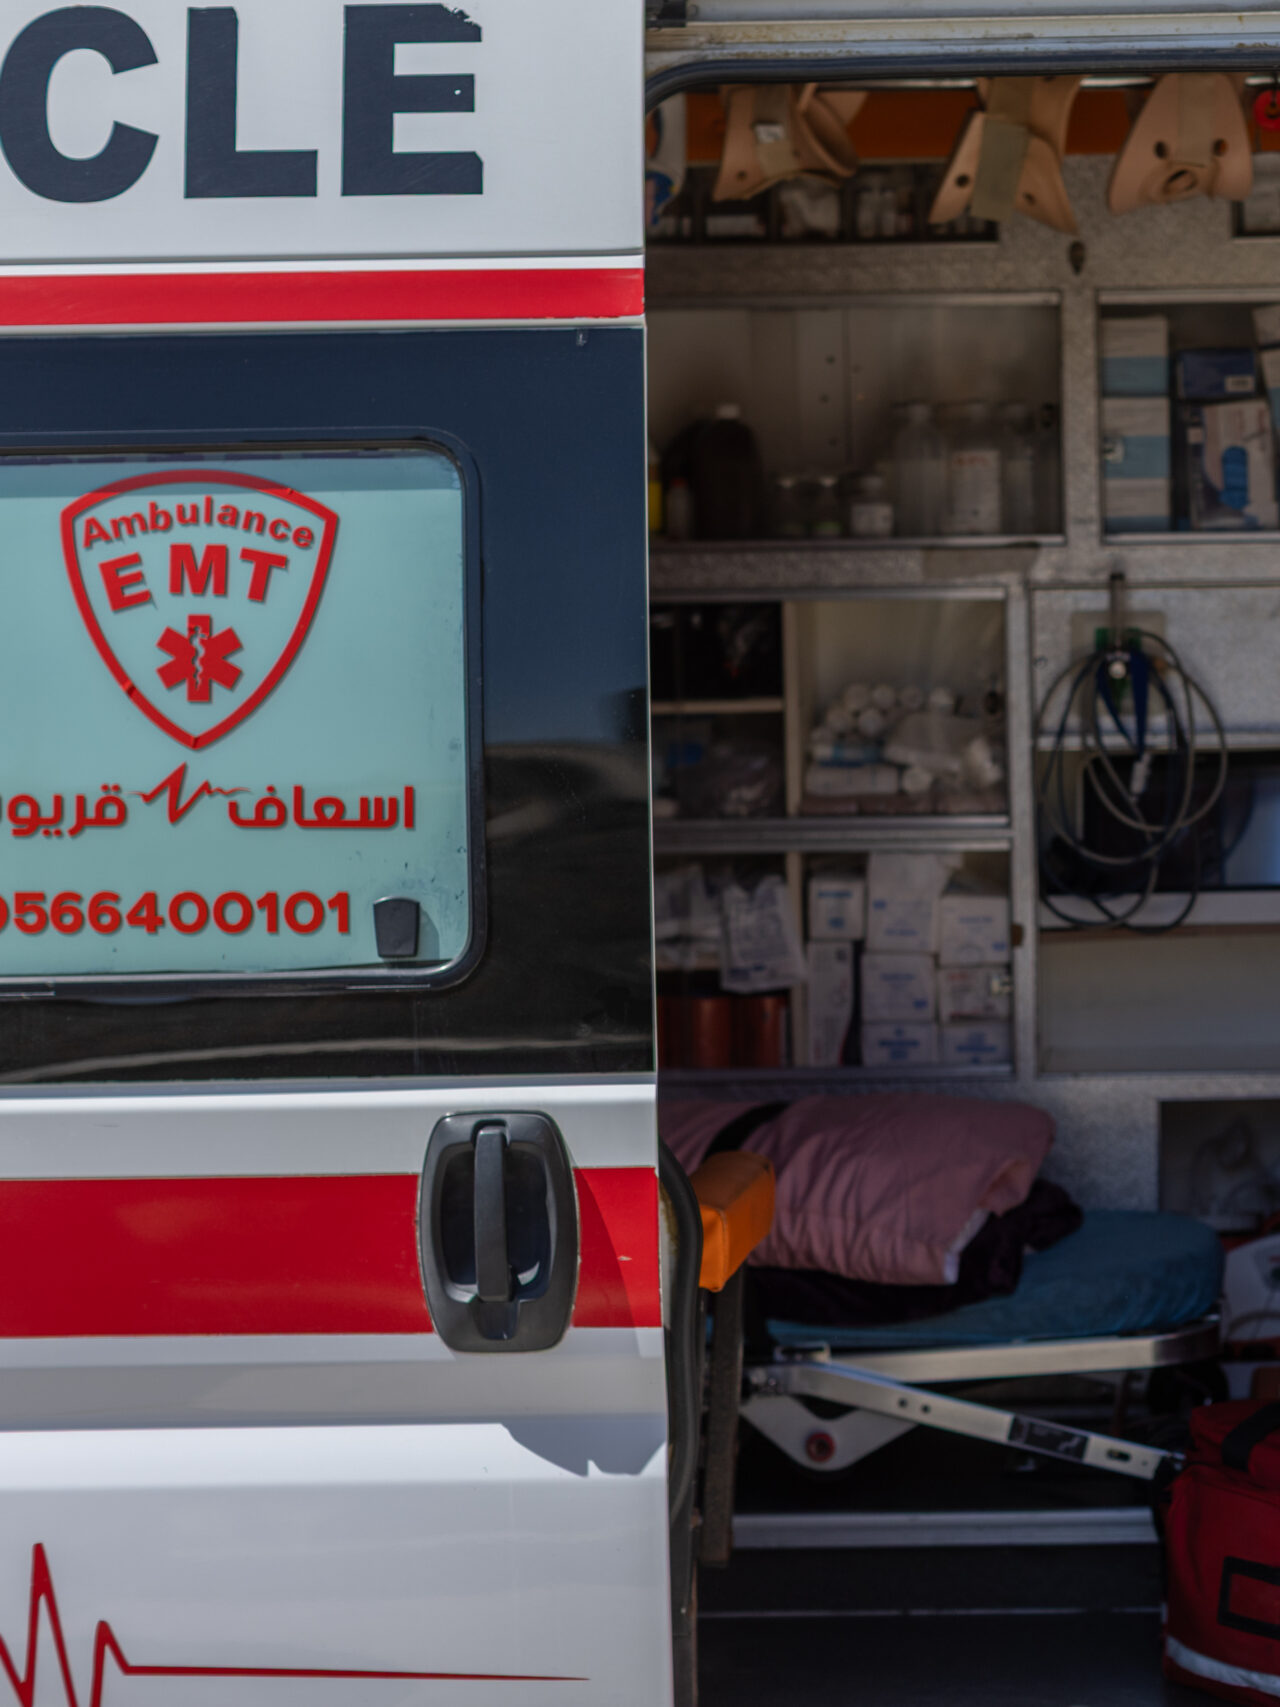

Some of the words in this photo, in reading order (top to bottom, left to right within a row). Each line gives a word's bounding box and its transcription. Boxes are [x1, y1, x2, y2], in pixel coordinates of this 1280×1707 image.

[0, 3, 484, 204] CLE
[82, 495, 315, 548] Ambulance
[98, 543, 289, 612] EMT
[0, 784, 127, 837] قريو
[228, 785, 415, 829] اسعاف
[0, 891, 351, 935] 566400101
